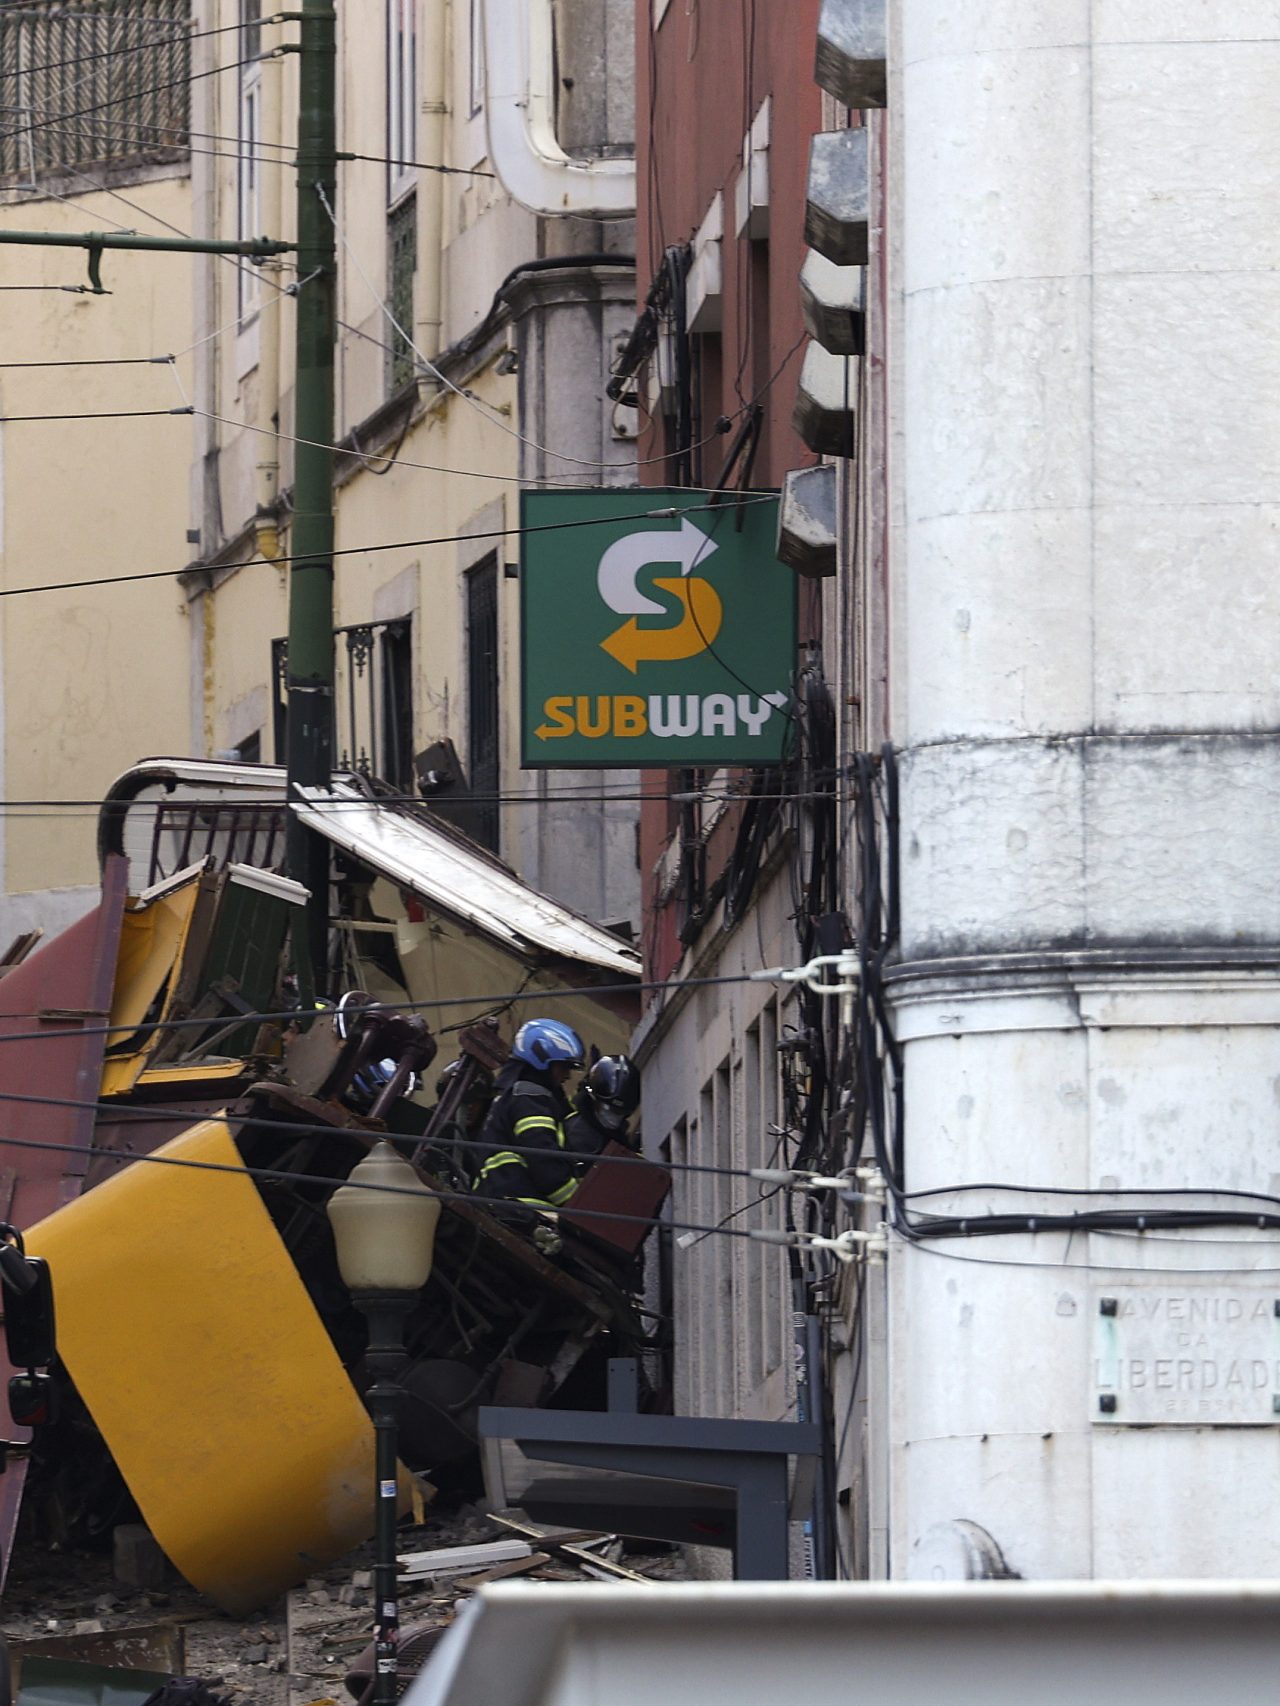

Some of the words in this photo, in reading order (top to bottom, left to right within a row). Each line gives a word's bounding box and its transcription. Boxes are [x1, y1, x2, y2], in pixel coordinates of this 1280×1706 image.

[533, 690, 789, 742] SUBWAY
[1118, 1297, 1271, 1322] AVENIDA
[1095, 1359, 1280, 1390] LIBERDAD
